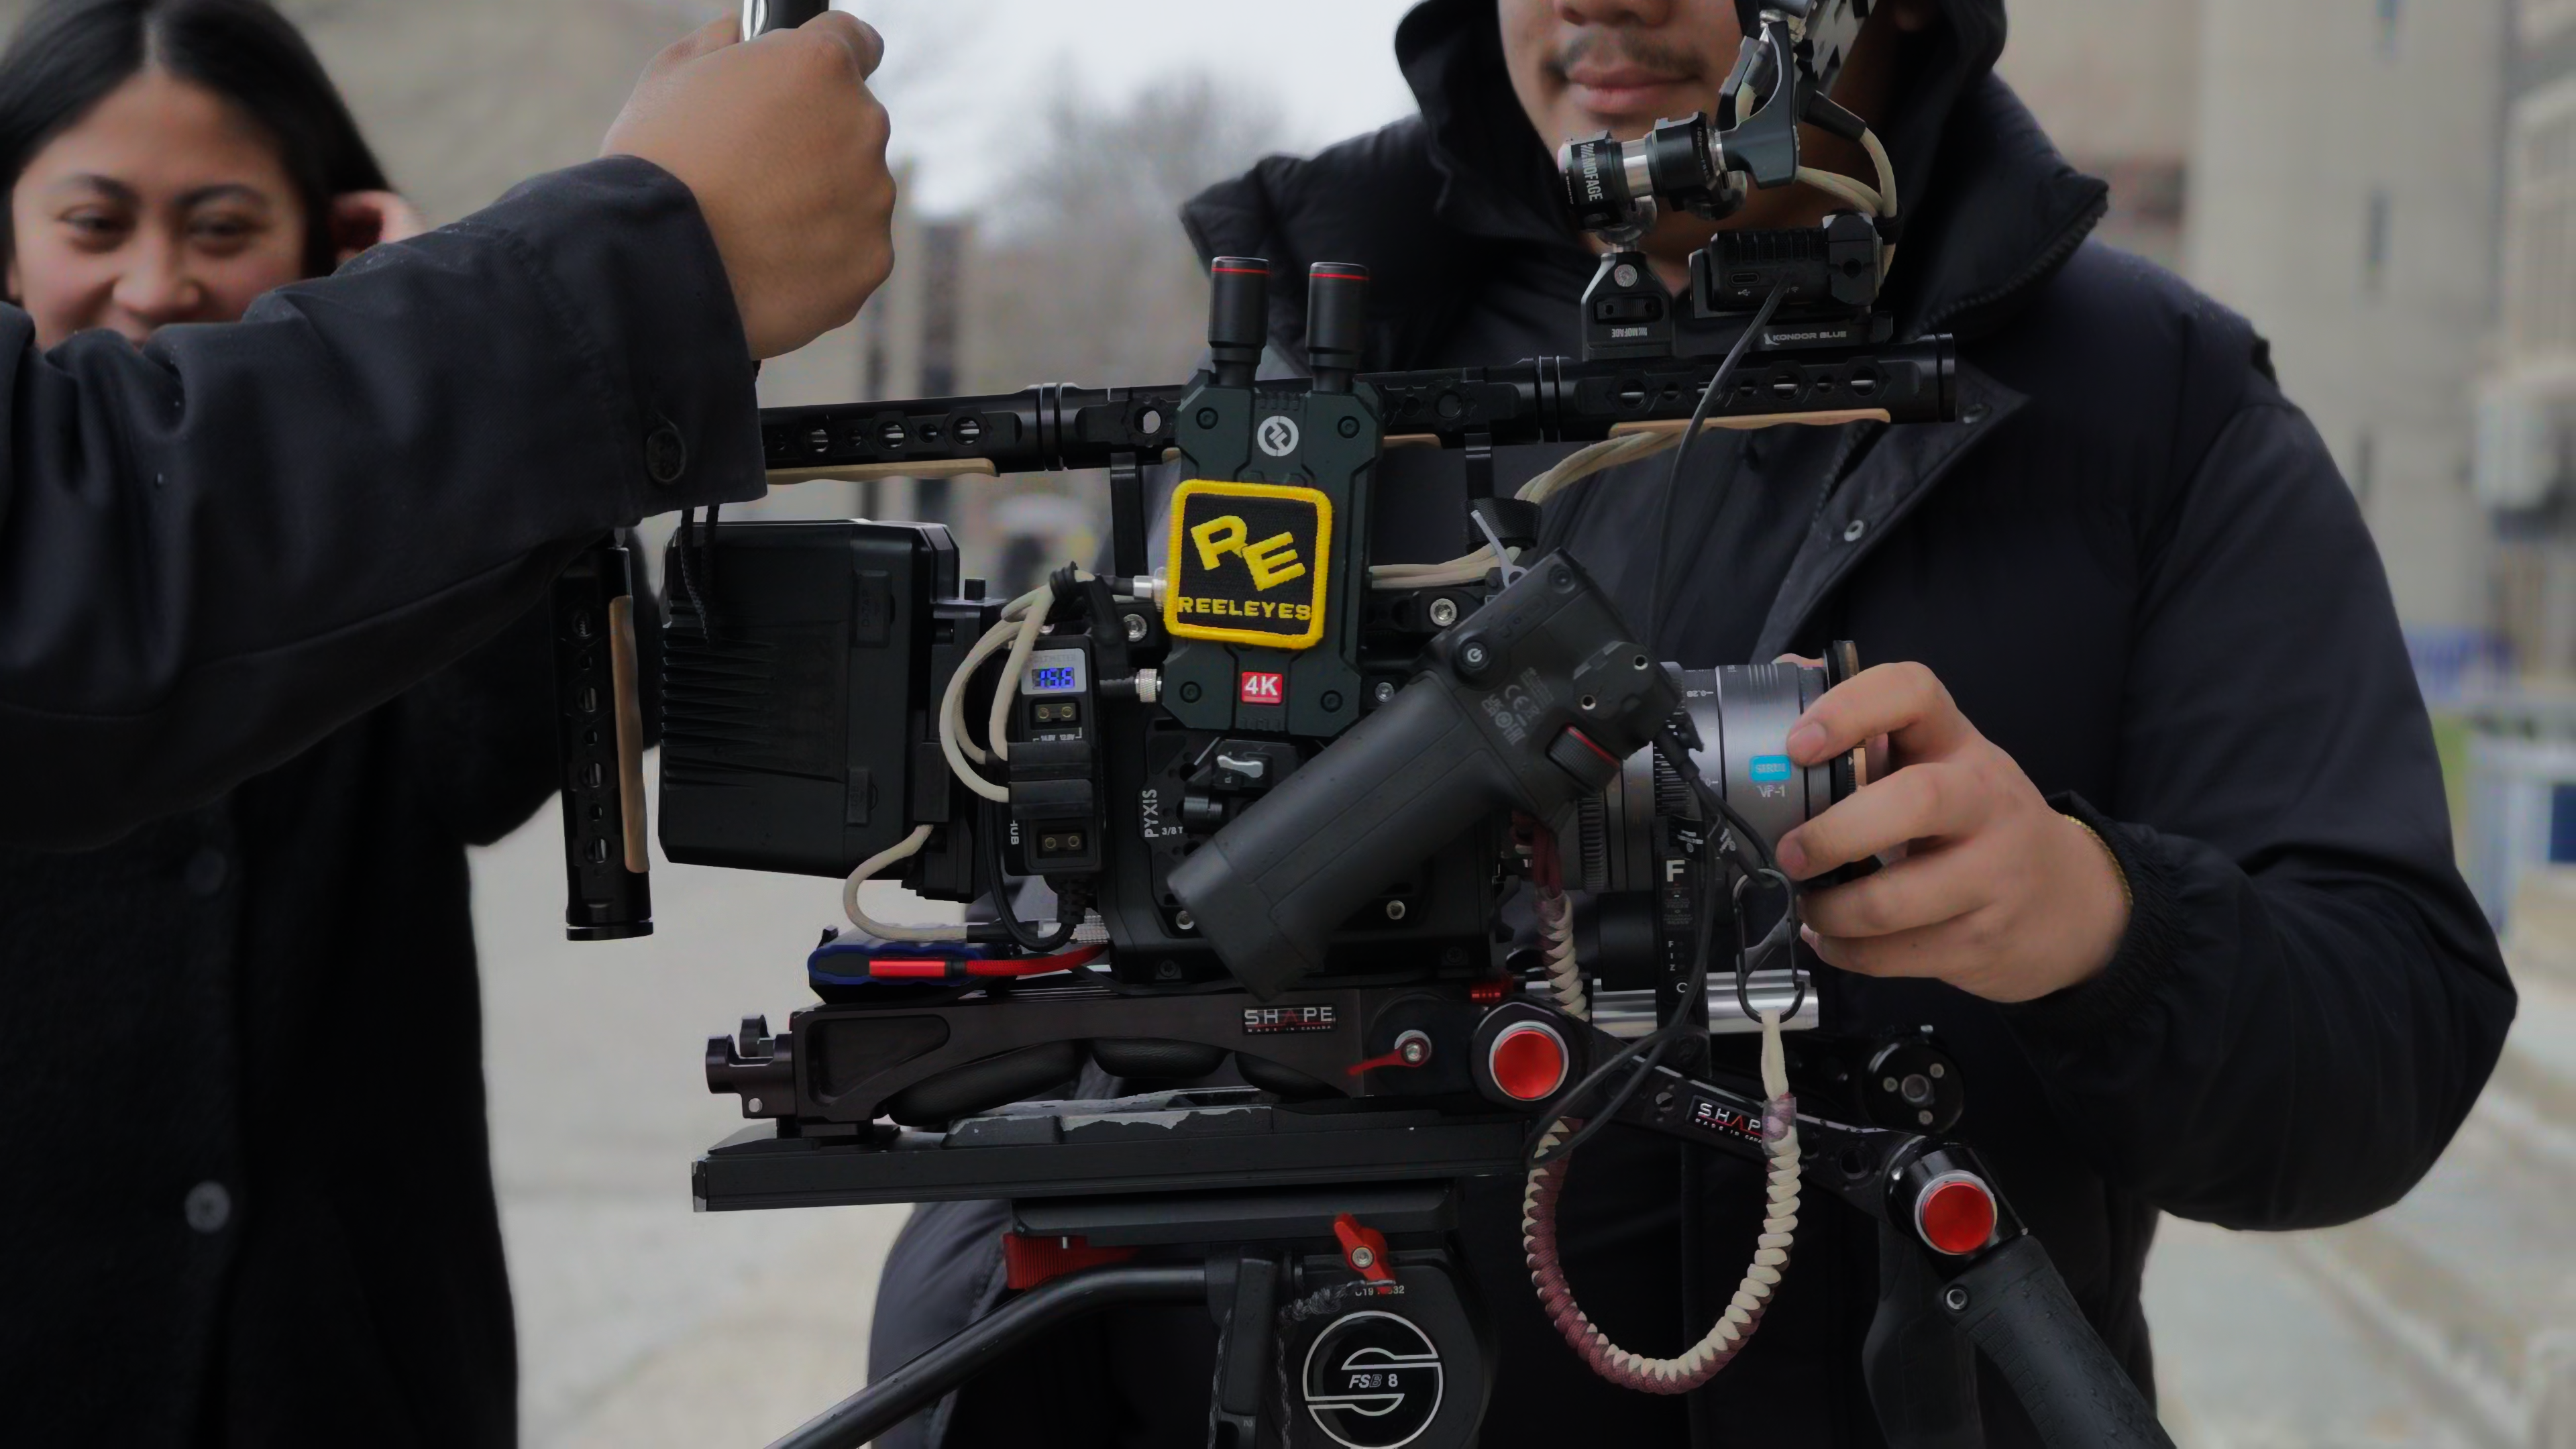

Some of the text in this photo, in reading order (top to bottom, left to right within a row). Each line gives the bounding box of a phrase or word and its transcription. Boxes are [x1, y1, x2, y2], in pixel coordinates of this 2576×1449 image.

[1581, 155, 1603, 202] MOFAGE
[1611, 327, 1638, 337] MOFAGE
[1773, 333, 1817, 341] KONDOR
[1191, 515, 1305, 591] RE
[1178, 596, 1311, 621] REELEYES
[1245, 676, 1279, 696] 4K
[1142, 789, 1159, 838] PYXIS
[1161, 826, 1177, 836] 3/8
[1666, 860, 1685, 882] F
[1244, 1007, 1333, 1025] SHAPE
[1698, 1103, 1762, 1131] SHAP
[1348, 1373, 1399, 1389] FSB 8
